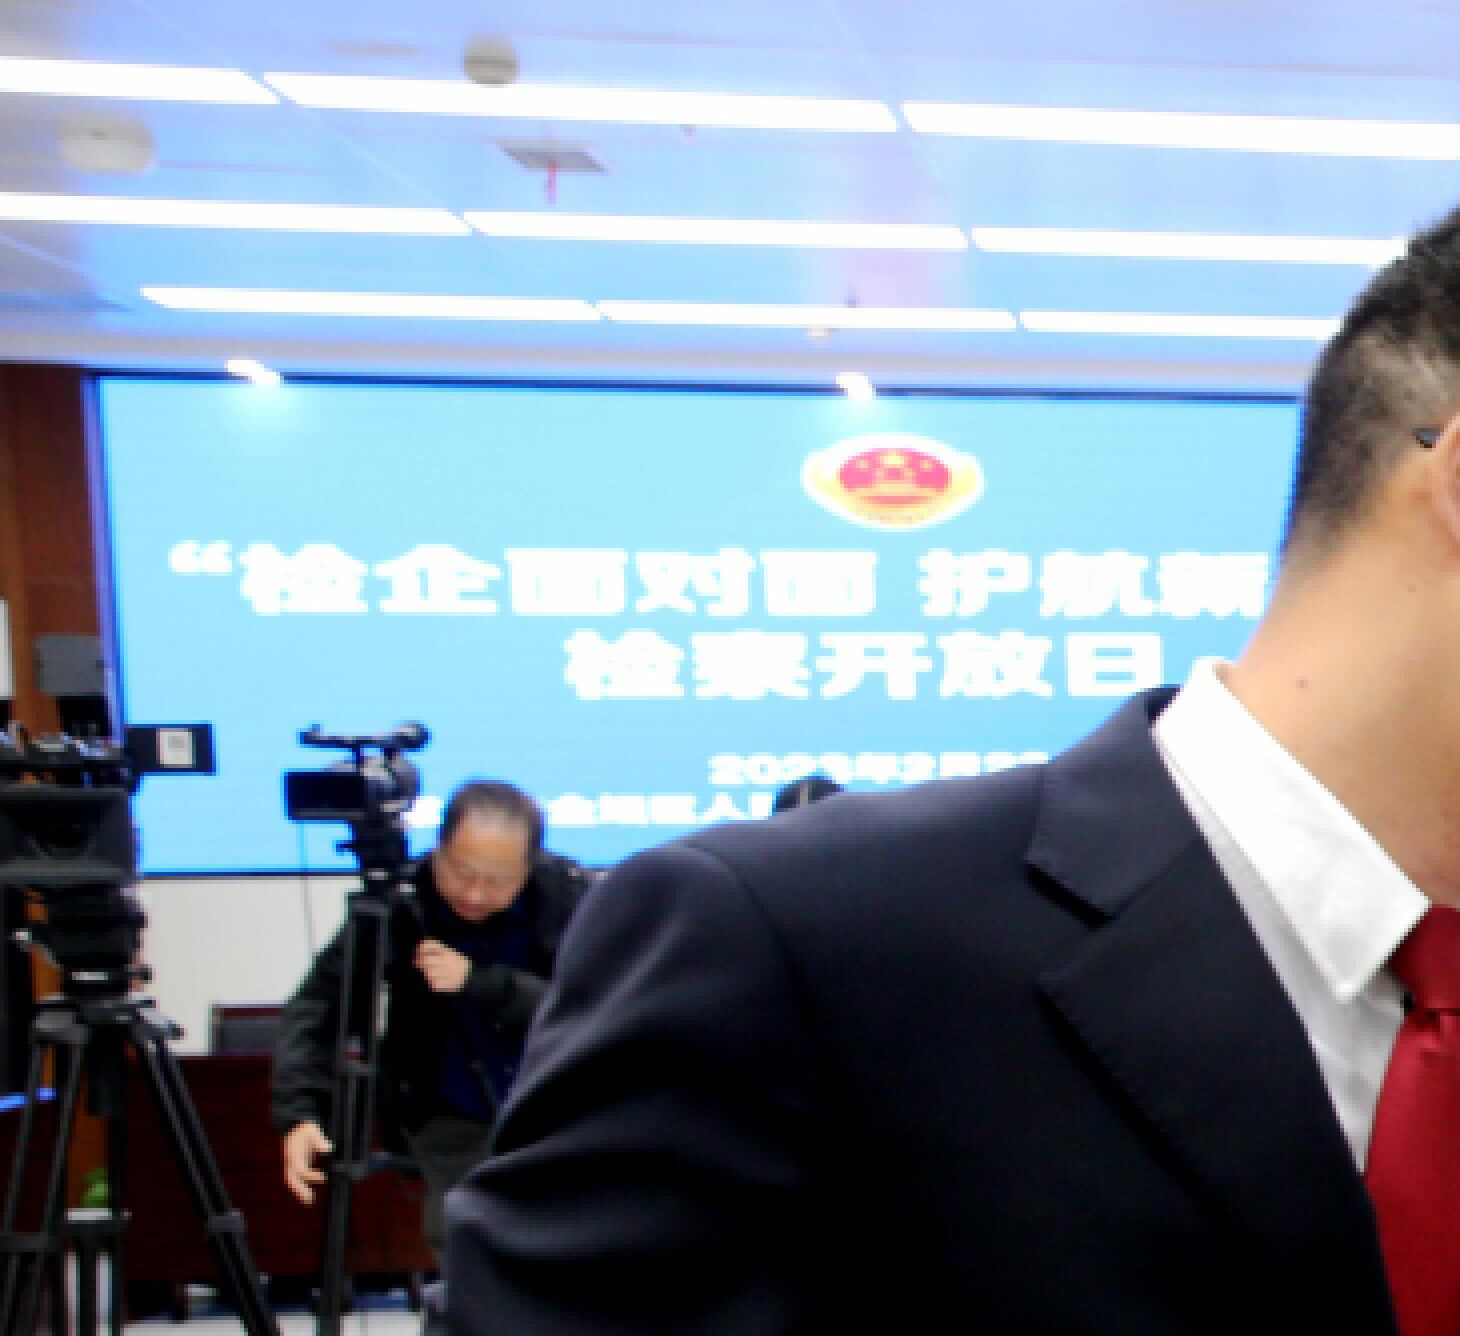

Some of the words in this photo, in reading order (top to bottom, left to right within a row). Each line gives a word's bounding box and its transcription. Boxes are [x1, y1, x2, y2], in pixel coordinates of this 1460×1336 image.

[563, 628, 1165, 701] 检察开放日
